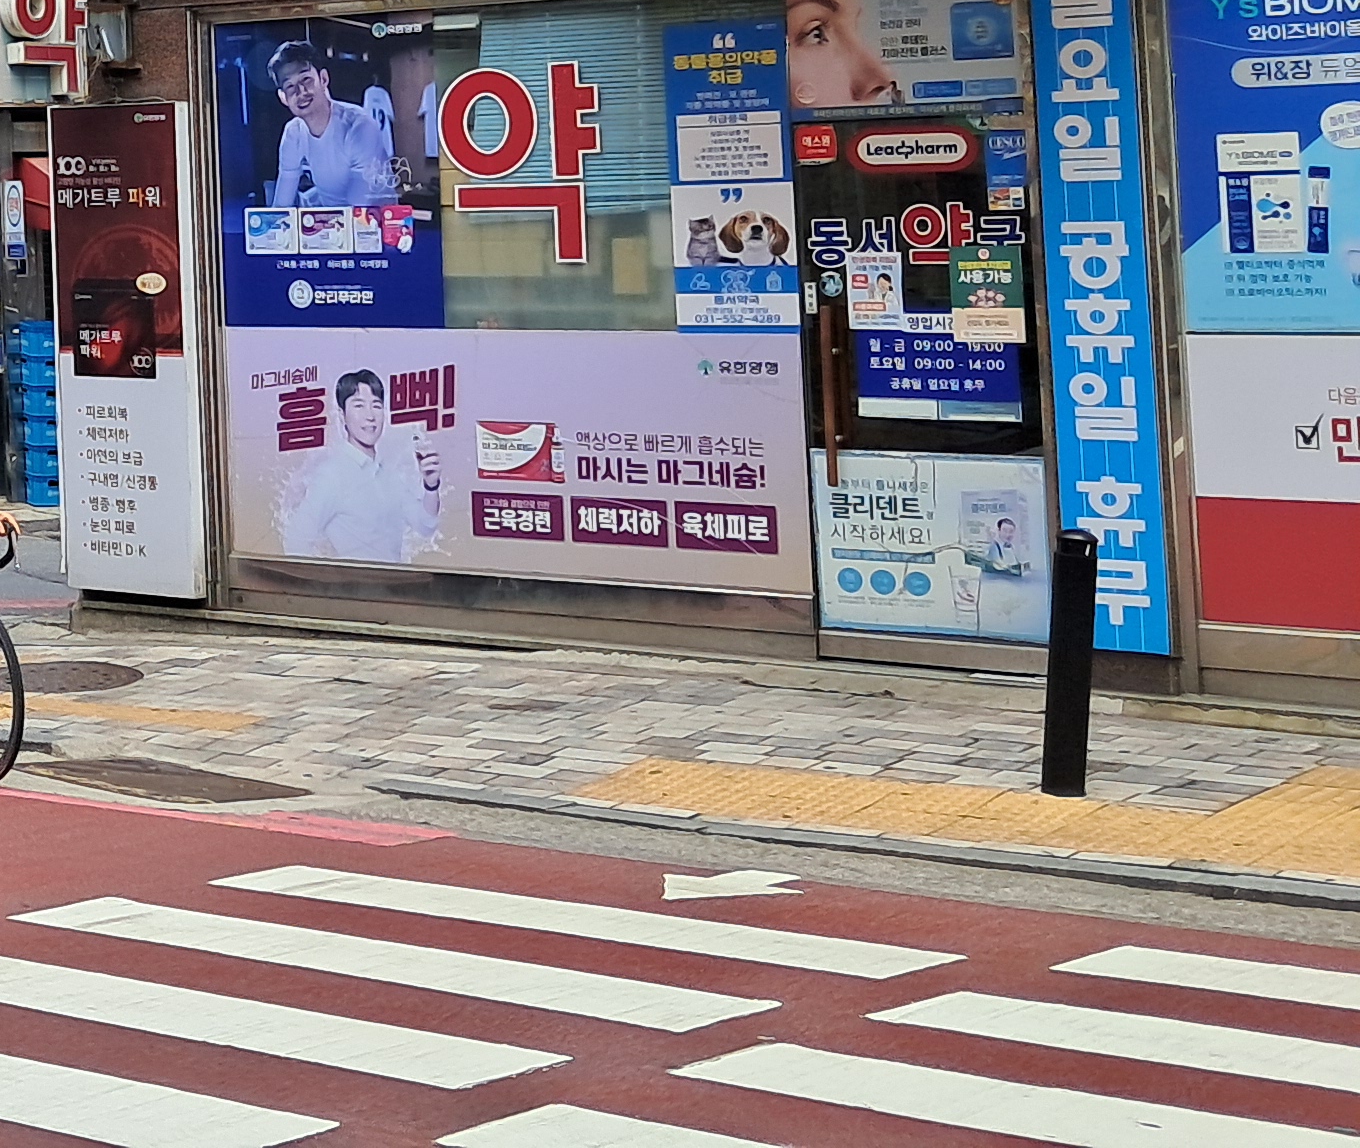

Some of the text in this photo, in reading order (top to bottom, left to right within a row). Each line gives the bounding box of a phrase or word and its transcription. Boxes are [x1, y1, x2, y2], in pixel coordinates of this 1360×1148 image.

[1250, 59, 1313, 82] 위&장
[866, 139, 958, 159] Leadpharm
[987, 136, 1026, 150] CESCO
[440, 60, 602, 265] 약
[57, 185, 161, 209] 메가트루 파워
[957, 270, 1013, 285] 사용가능
[694, 313, 782, 324] 031-552-4289
[1059, 219, 1139, 442] 공휴일
[78, 329, 122, 344] 메가트루
[913, 339, 954, 352] 09:00
[79, 343, 101, 359] 파워
[869, 356, 1006, 371] 토요일 09:00 14:00
[251, 365, 318, 390] 마그네슘에
[276, 386, 327, 452] 흠
[576, 431, 765, 458] 액상으로 빠르게 흡수되는
[576, 455, 767, 490] 마시는 마그네슘!
[829, 492, 924, 521] 클리덴트
[482, 508, 552, 533] 근육경련
[577, 505, 662, 537] 체력저하
[682, 511, 770, 543] 육체피로
[831, 523, 932, 546] 시작하세요!
[1074, 474, 1150, 628] 휴무
